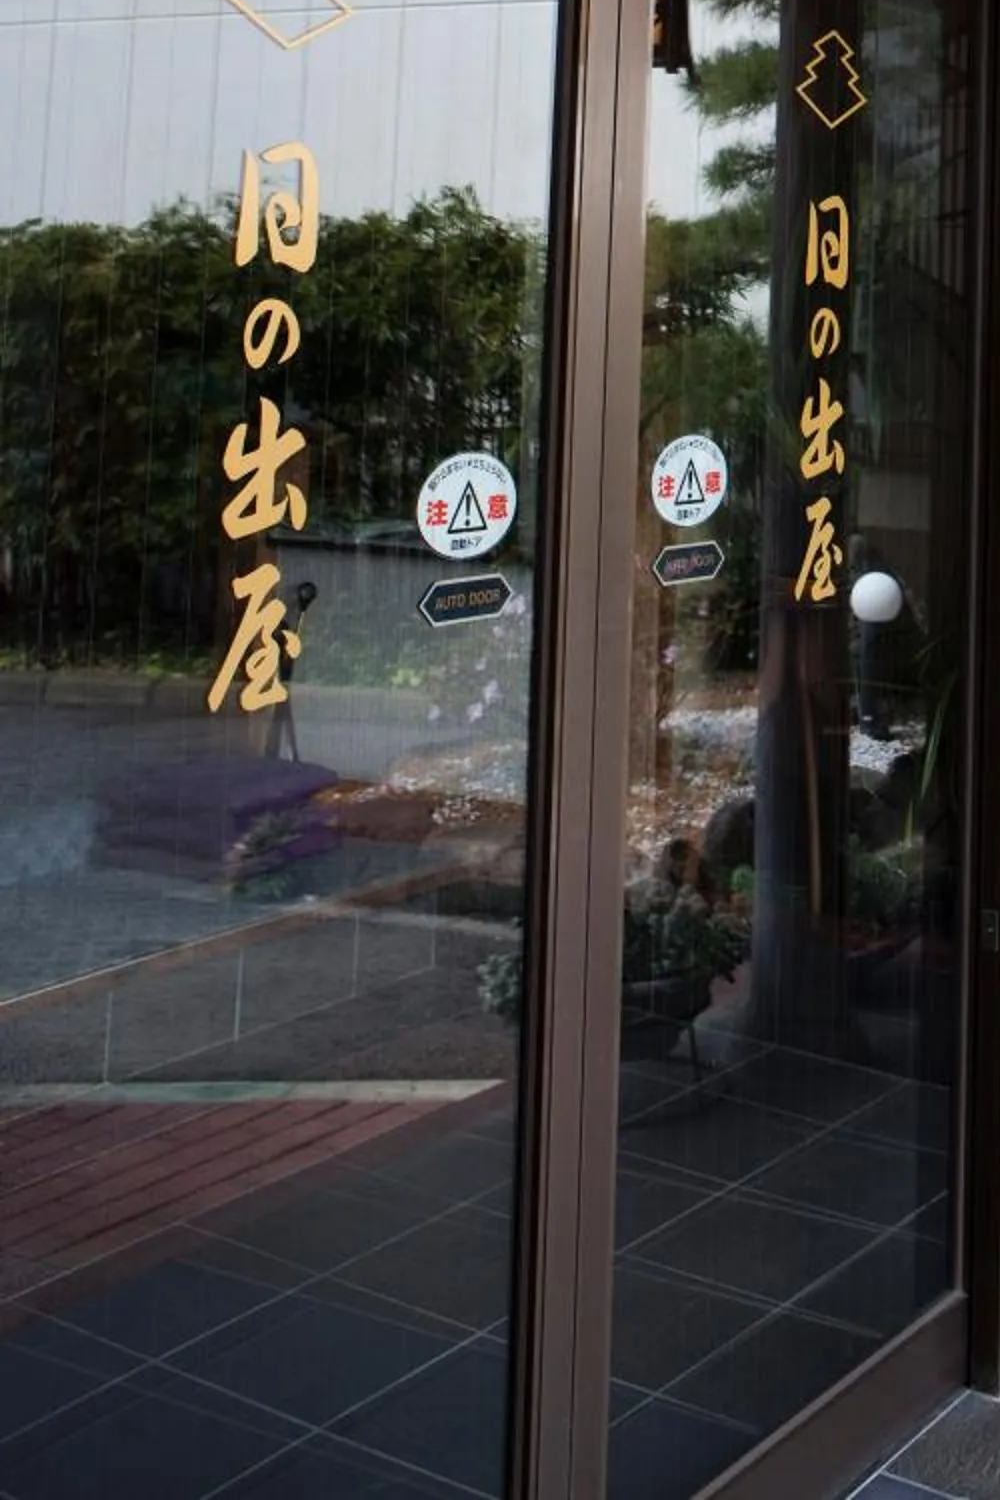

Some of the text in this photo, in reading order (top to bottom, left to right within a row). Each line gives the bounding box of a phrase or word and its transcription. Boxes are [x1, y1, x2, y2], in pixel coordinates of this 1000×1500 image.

[208, 140, 319, 713] 日の出屋
[435, 588, 501, 610] AUTO DOOR
[795, 195, 850, 602] 日の出屋
